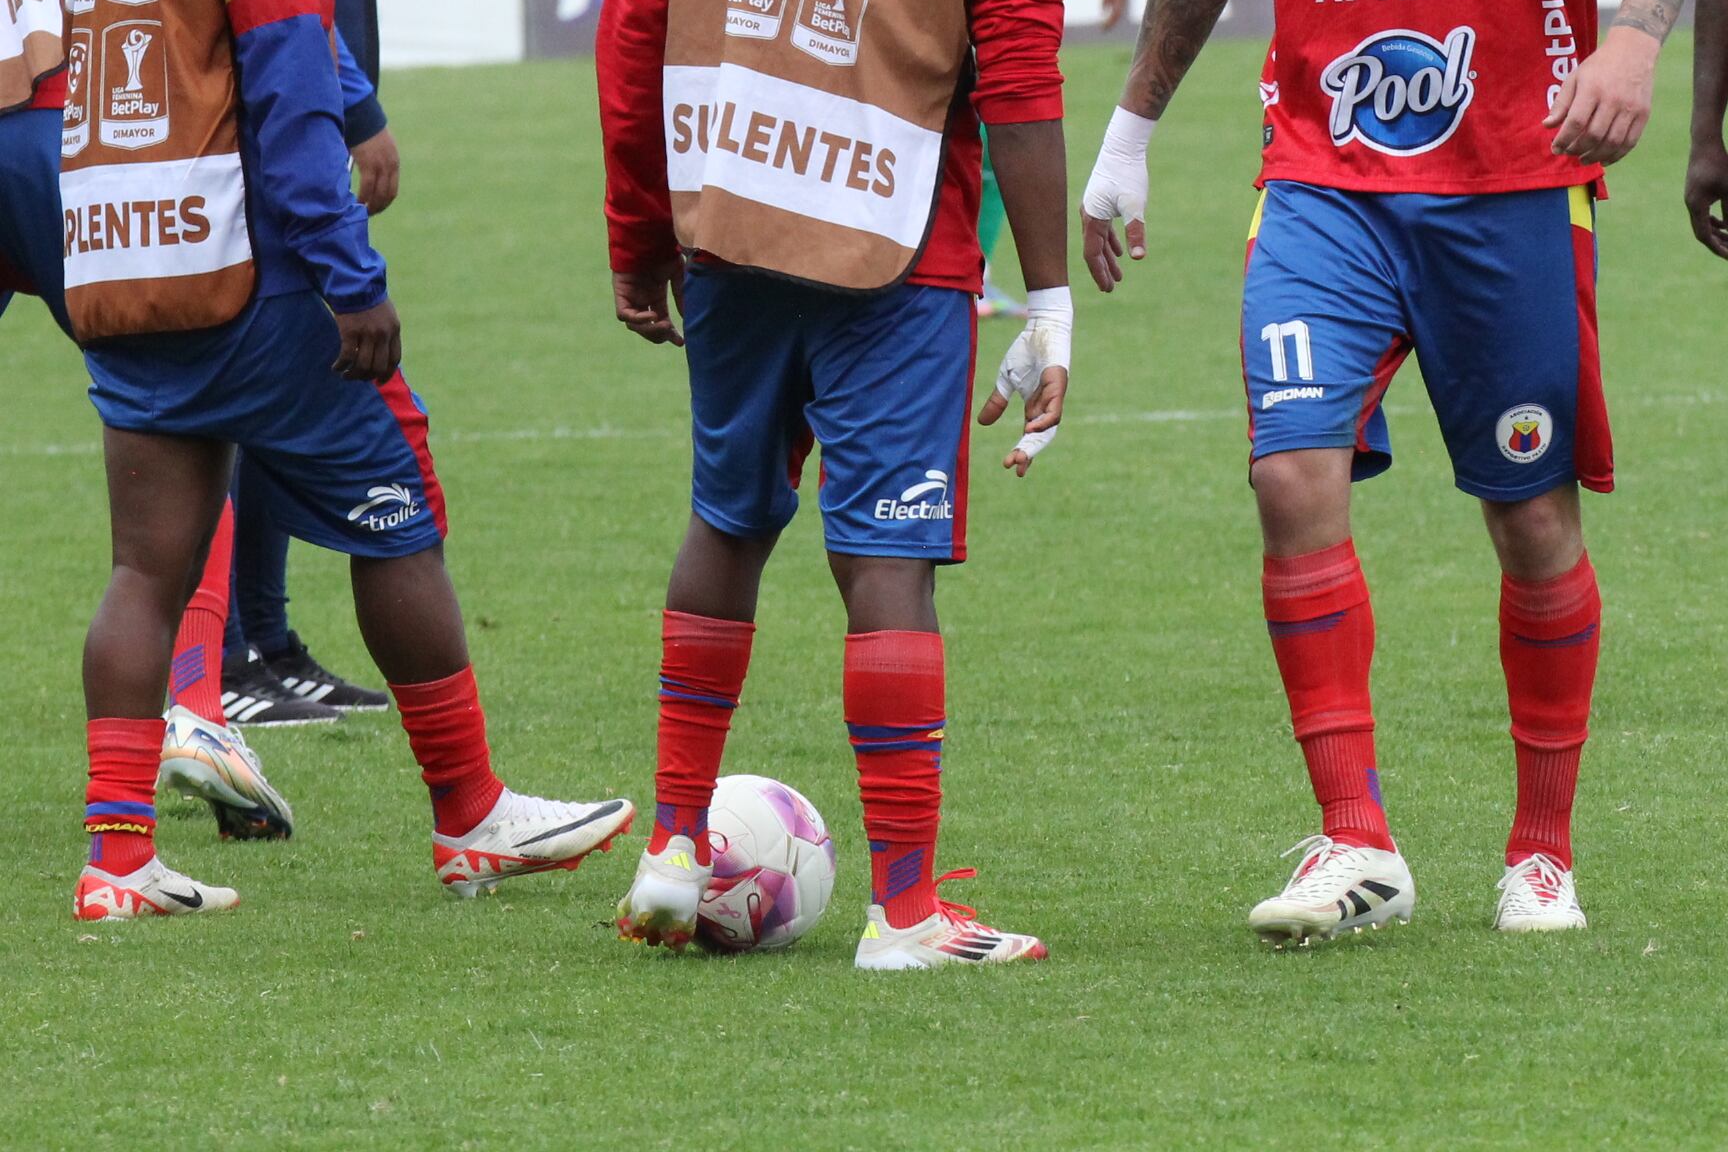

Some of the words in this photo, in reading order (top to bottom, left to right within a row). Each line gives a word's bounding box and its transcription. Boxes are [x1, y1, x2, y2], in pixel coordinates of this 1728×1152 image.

[1325, 31, 1470, 140] Pool
[111, 99, 160, 117] BetPlay
[113, 128, 155, 139] DIMAYOR
[673, 101, 896, 198] SULENTES
[64, 195, 211, 258] PLENTES
[1260, 319, 1314, 382] 11
[361, 500, 420, 532] trolit
[874, 499, 954, 520] Electit
[85, 822, 149, 835] OMAN
